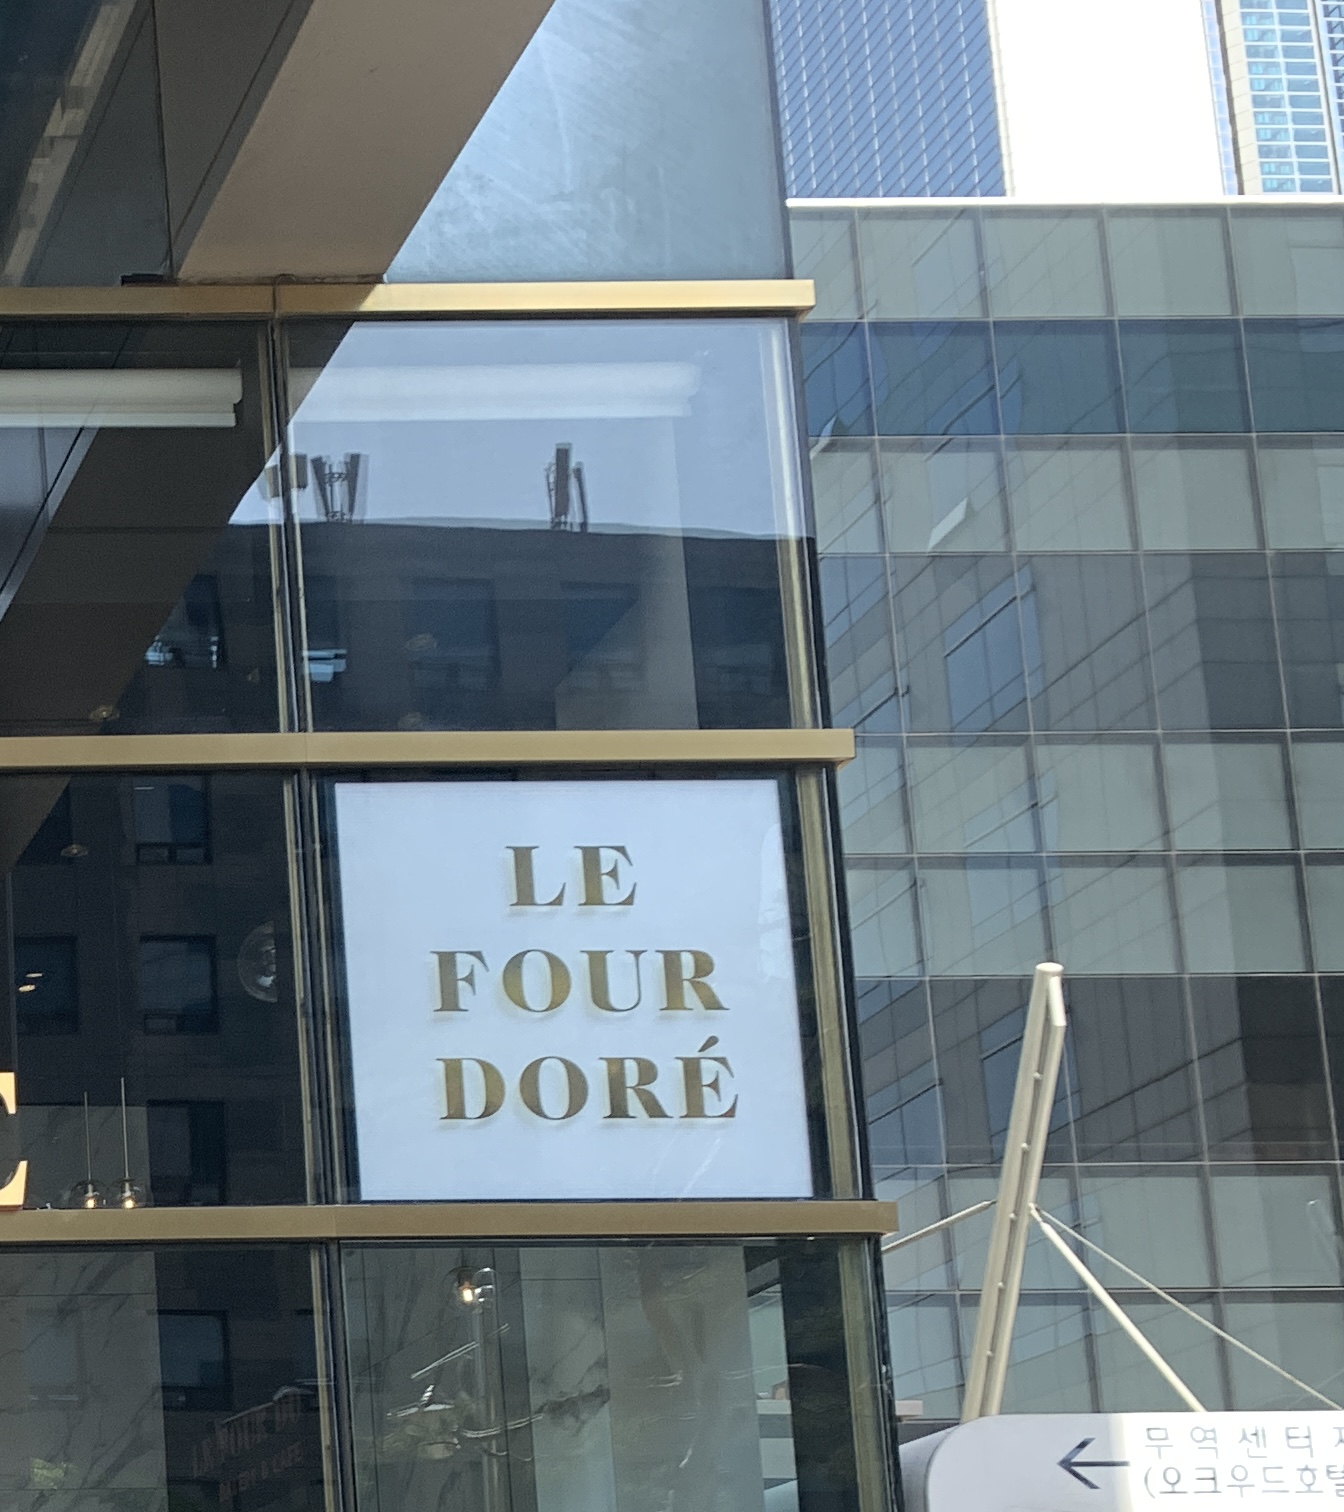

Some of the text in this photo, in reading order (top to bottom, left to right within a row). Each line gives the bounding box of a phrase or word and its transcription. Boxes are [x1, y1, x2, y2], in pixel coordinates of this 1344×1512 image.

[504, 844, 638, 907] LE
[429, 948, 730, 1013] FOUR
[435, 1035, 739, 1121] DORÉ
